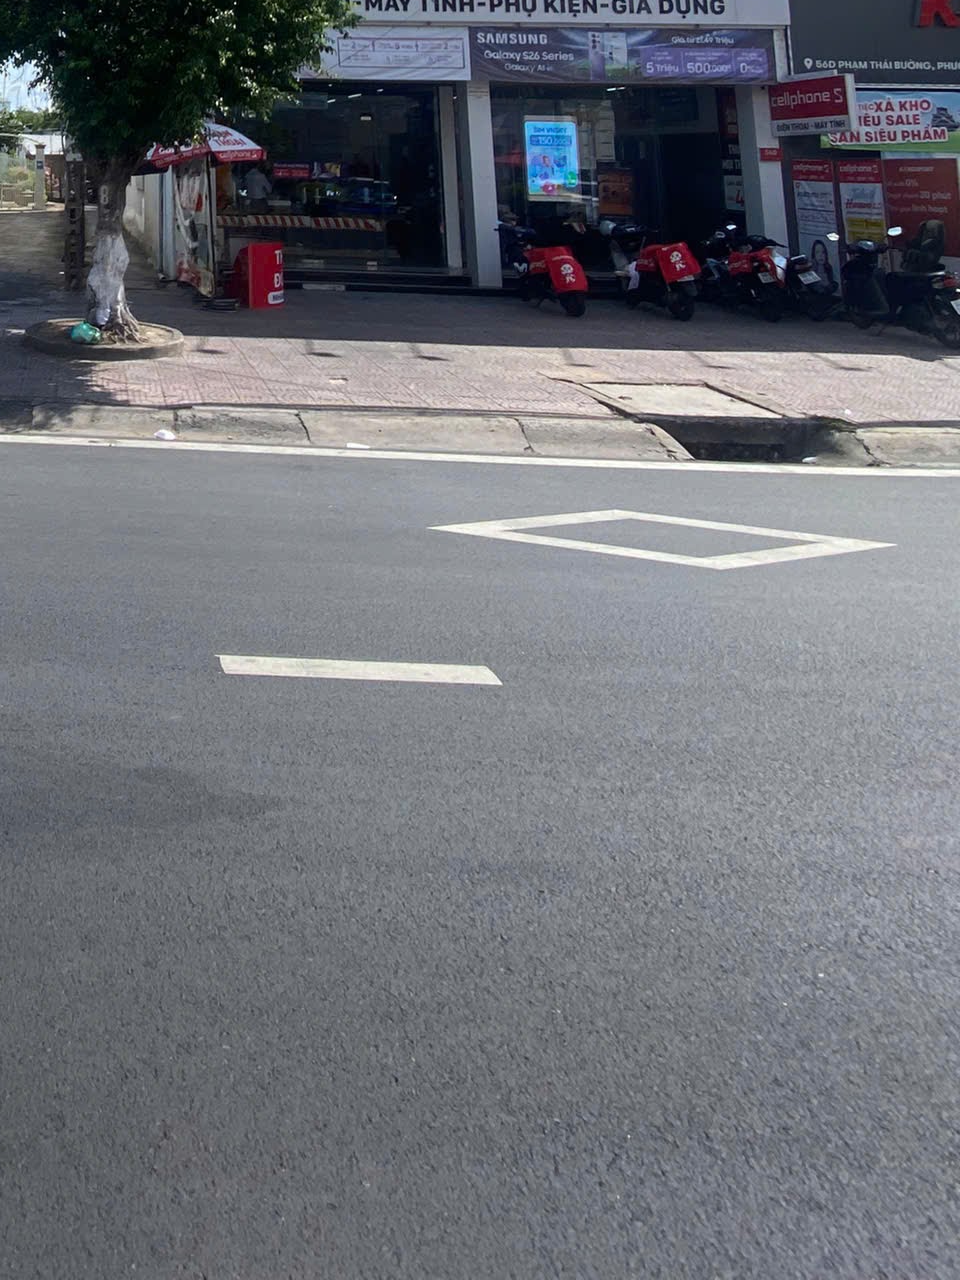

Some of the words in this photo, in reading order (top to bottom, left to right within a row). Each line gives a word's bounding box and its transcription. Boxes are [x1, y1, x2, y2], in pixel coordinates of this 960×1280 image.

[477, 32, 548, 45] SAMSUNG
[484, 50, 521, 61] Galaxy
[522, 51, 540, 61] S26
[541, 51, 575, 61] Series
[504, 63, 536, 73] Galaxy
[815, 59, 836, 69] 56D
[870, 58, 893, 70] THÁI
[771, 90, 830, 109] cellphone
[898, 99, 932, 112] KHO
[858, 113, 881, 127] IÊU
[886, 114, 921, 127] SALE
[864, 127, 898, 143] SIÊU
